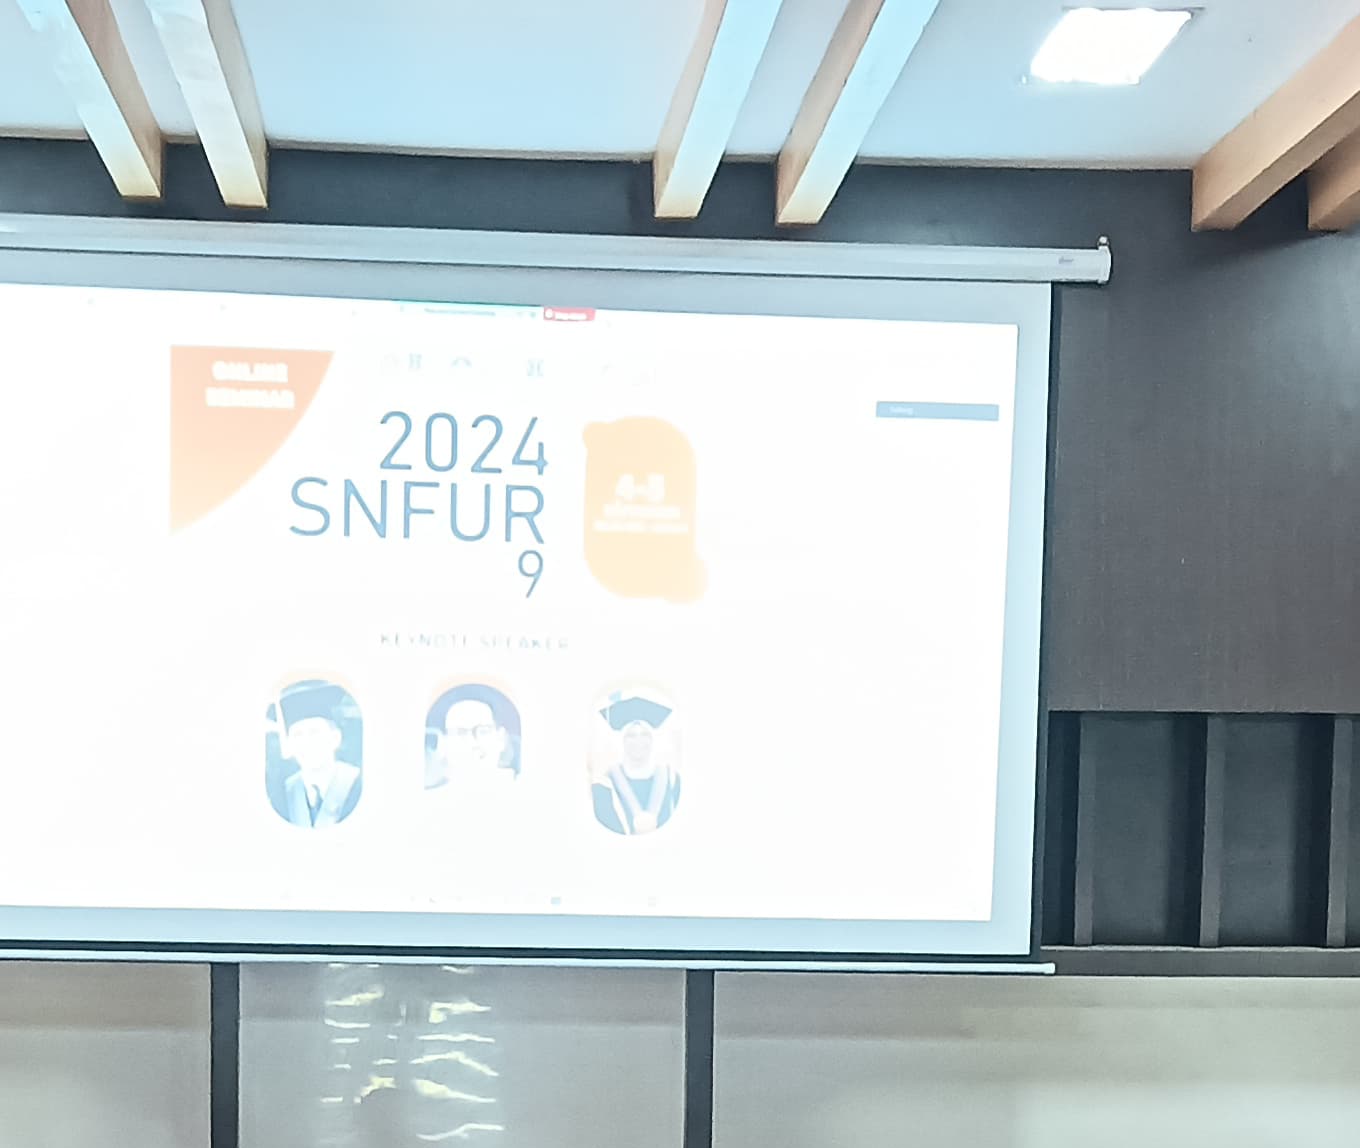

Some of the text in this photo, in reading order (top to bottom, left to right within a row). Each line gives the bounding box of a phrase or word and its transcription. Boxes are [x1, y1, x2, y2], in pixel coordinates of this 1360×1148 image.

[379, 410, 549, 476] 2024
[289, 476, 545, 545] SNFUR
[517, 549, 544, 599] 9
